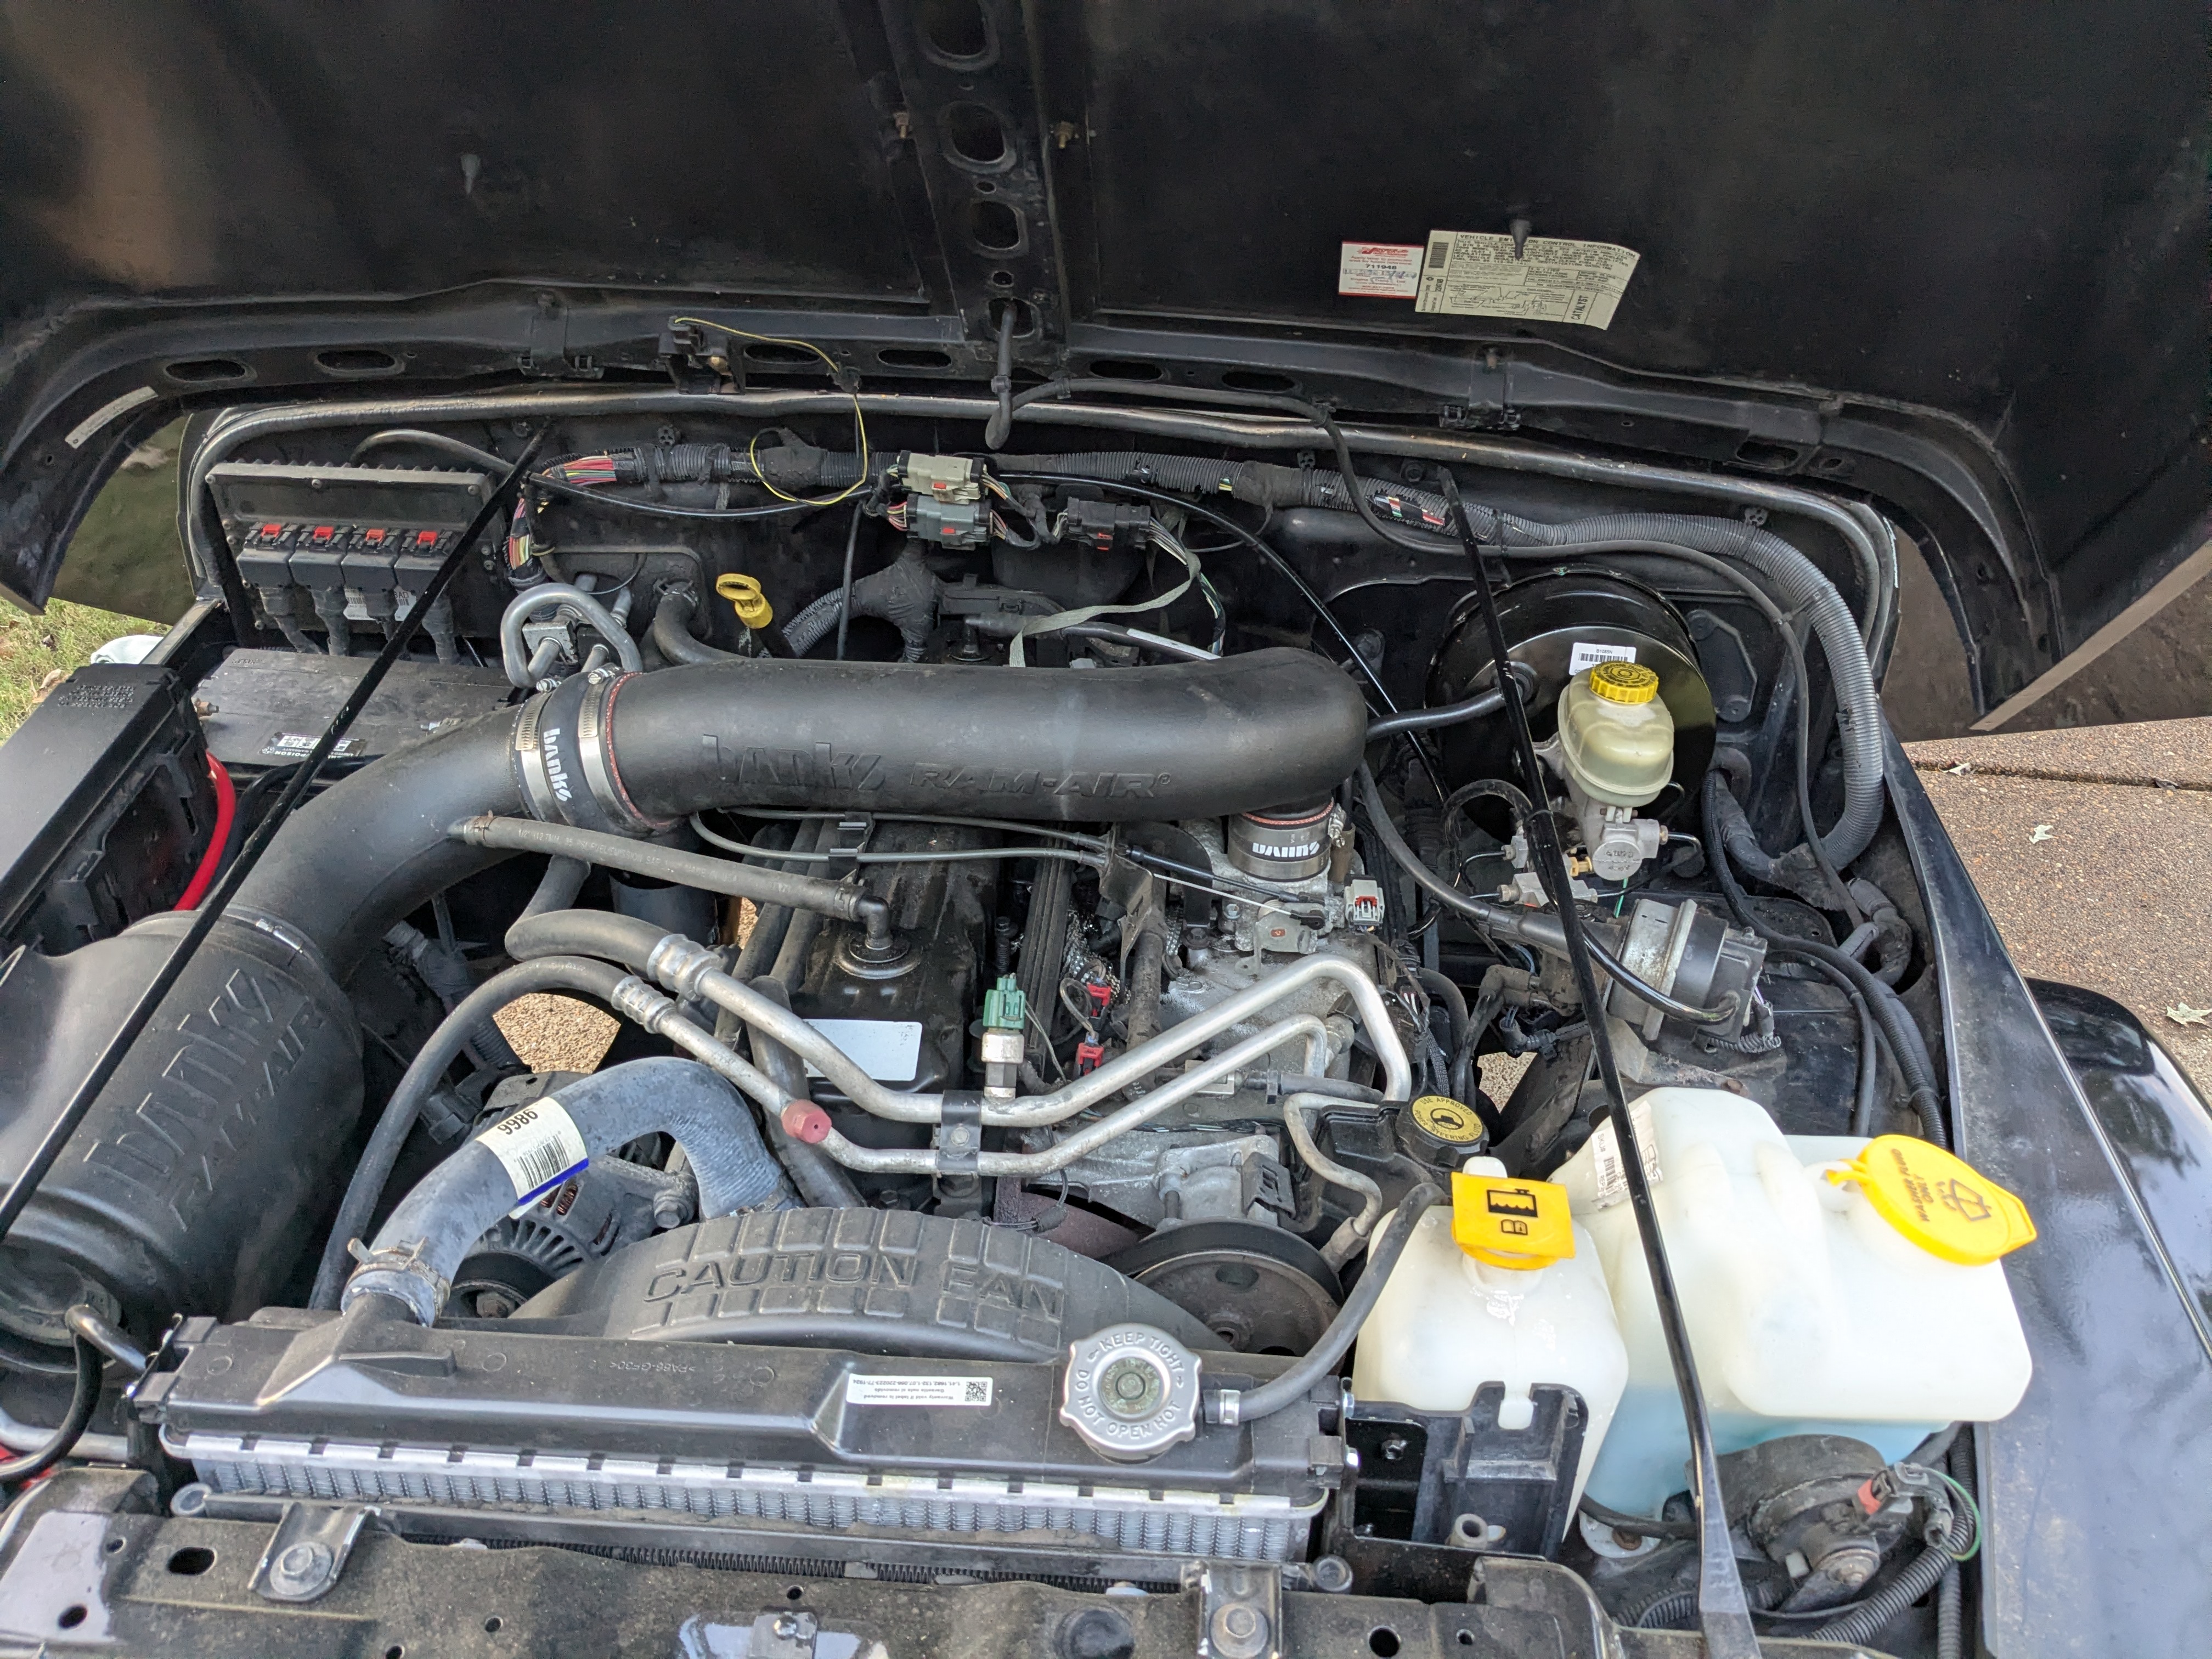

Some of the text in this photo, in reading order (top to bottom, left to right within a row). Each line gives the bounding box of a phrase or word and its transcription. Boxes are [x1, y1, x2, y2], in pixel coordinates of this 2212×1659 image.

[1583, 244, 1636, 258] INFORMATION
[1571, 295, 1589, 320] CATALYST
[1420, 1097, 1472, 1116] USE APPROVED
[496, 1109, 539, 1135] 9986
[1414, 1109, 1482, 1141] POWER STEERING FLUID
[644, 1252, 1066, 1324] CAUTION FAN
[1099, 1331, 1186, 1373] KEEP TIGHT
[1075, 1369, 1091, 1392] DO
[1077, 1395, 1105, 1425] NOT
[1153, 1400, 1182, 1431] HOT
[1107, 1421, 1153, 1440] OPEN
